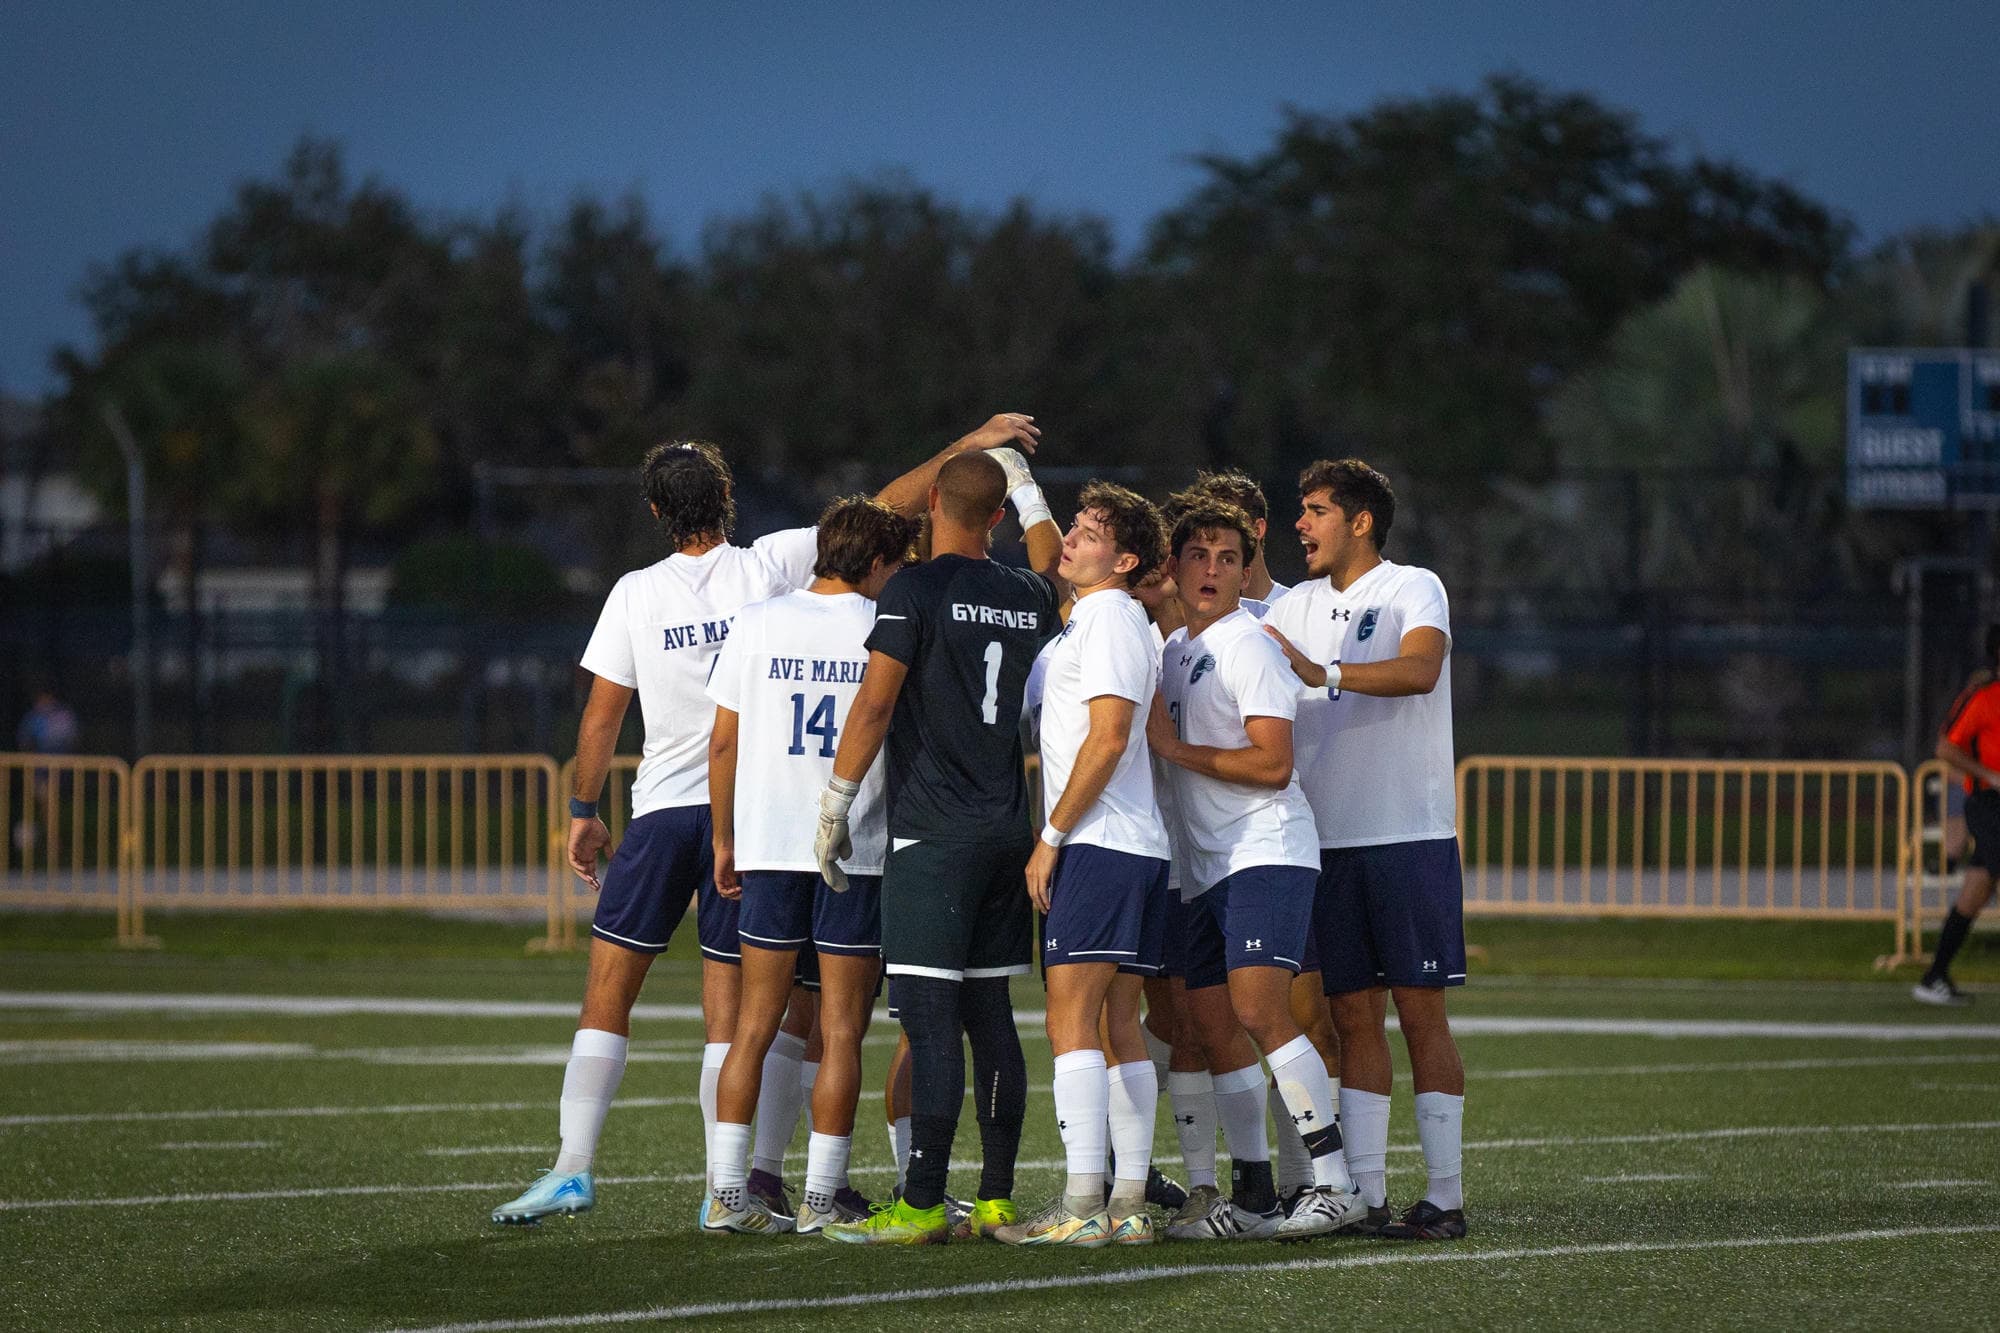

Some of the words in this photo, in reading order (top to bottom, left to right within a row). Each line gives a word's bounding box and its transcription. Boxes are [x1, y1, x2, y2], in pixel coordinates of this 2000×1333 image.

[663, 625, 698, 650] AVE
[702, 616, 735, 643] MA
[951, 603, 1038, 630] GYRENES
[768, 658, 804, 681] AVE
[981, 641, 1003, 725] 1
[788, 693, 838, 759] 14
